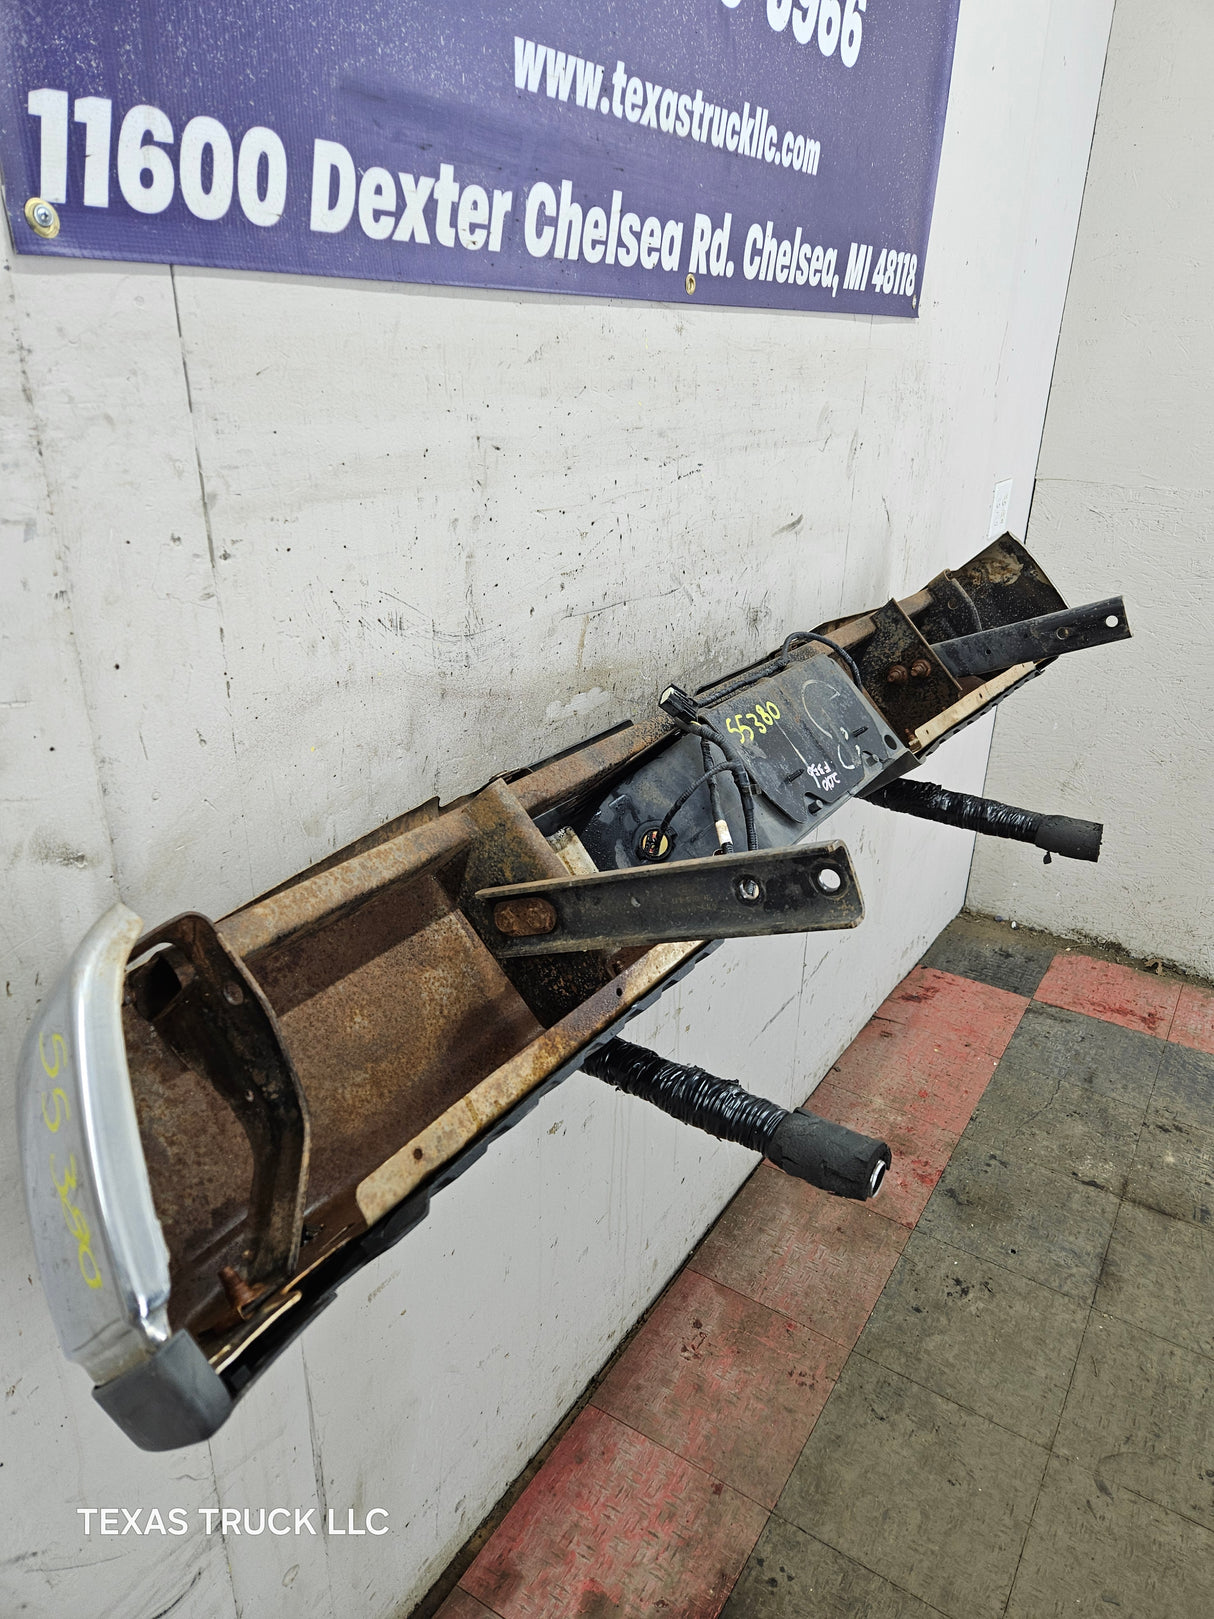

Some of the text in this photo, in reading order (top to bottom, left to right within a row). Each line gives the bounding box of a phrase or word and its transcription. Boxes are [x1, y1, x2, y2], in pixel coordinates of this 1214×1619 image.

[514, 36, 821, 176] www.texastruckllc.com
[27, 88, 918, 298] 11600 Dexter Chelsea Rd. Chelsea, MI 48118
[725, 701, 781, 744] 55380
